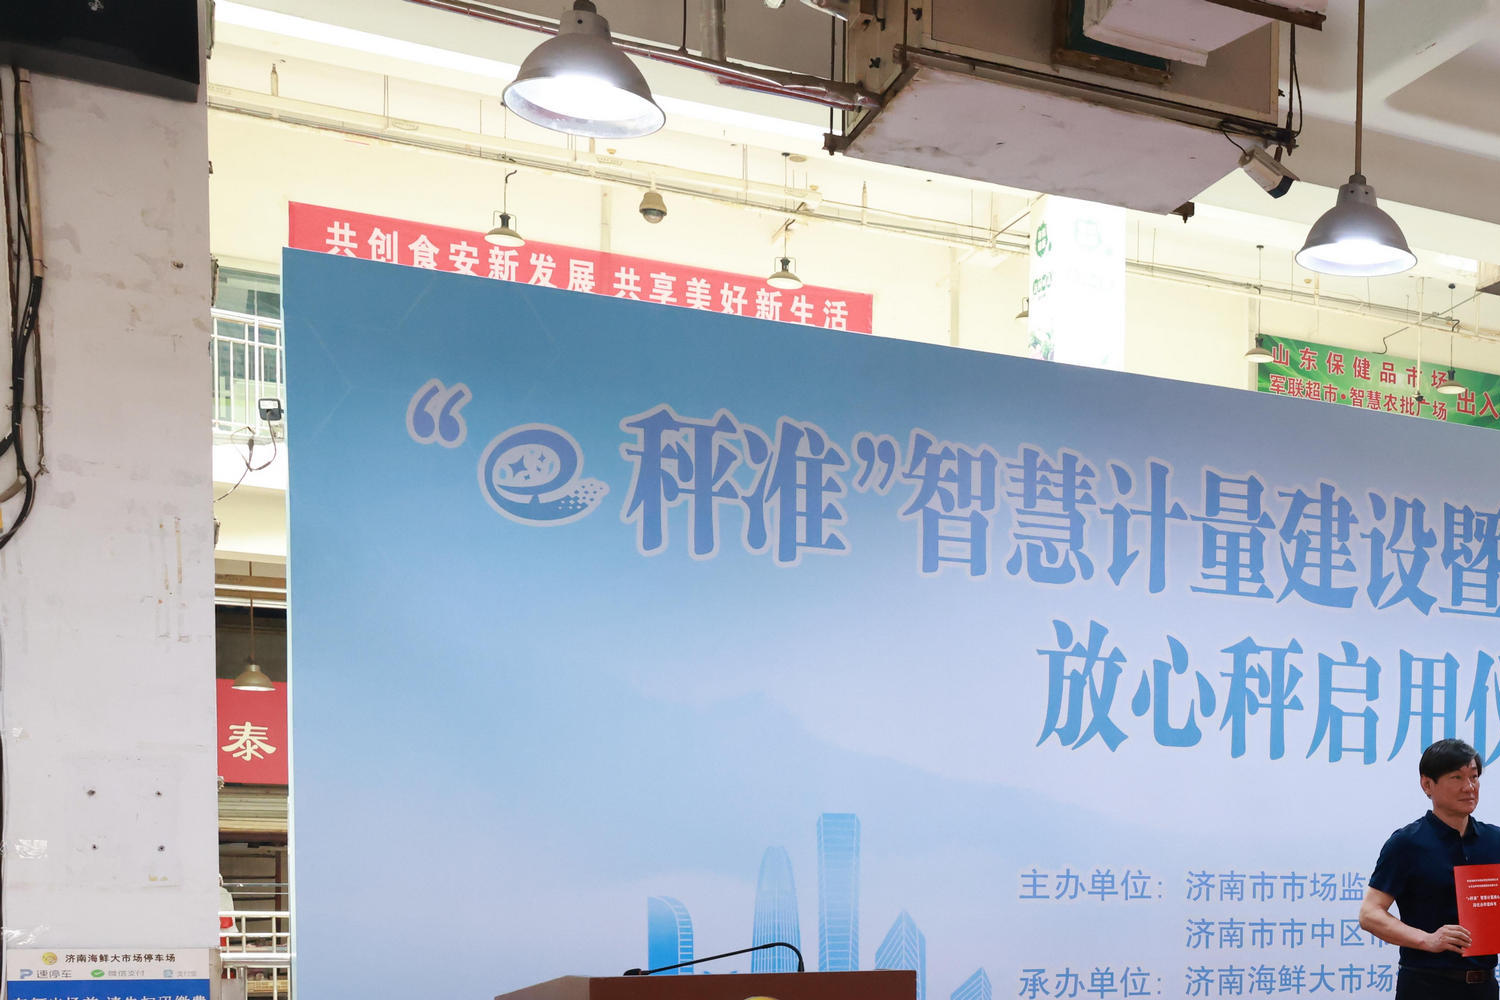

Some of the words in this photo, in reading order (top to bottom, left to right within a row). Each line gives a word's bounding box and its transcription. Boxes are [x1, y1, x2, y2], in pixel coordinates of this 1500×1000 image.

[325, 221, 596, 294] 共创食安新发展
[613, 266, 849, 332] 共享美好新生活
[1272, 343, 1447, 388] 山东保健品市场
[220, 722, 278, 761] 泰
[65, 953, 176, 964] 济南海鲜大市场停车场
